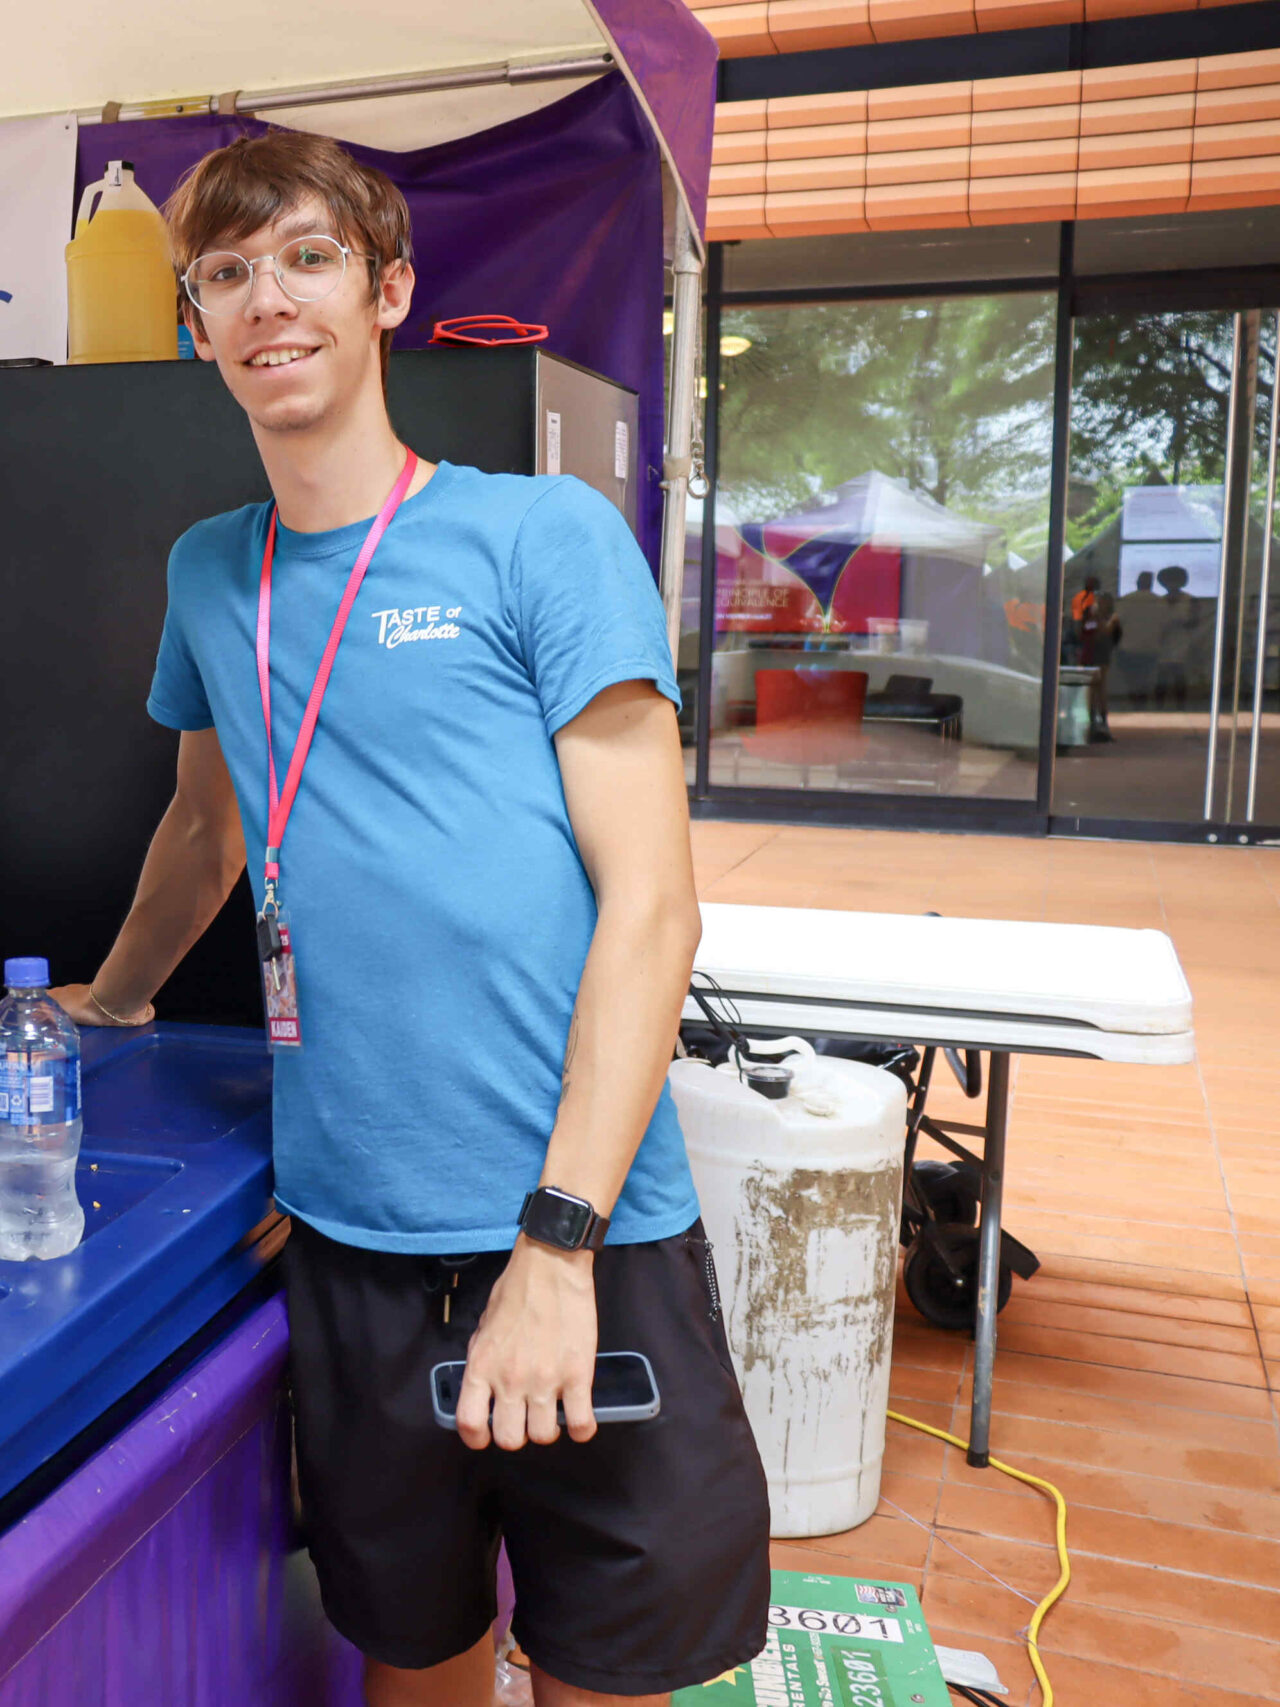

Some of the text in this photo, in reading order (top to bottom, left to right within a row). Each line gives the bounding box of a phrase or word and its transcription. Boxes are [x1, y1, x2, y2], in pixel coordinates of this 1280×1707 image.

[371, 606, 441, 644] TASTE
[386, 622, 461, 650] Charlotte
[840, 1649, 885, 1707] 23601
